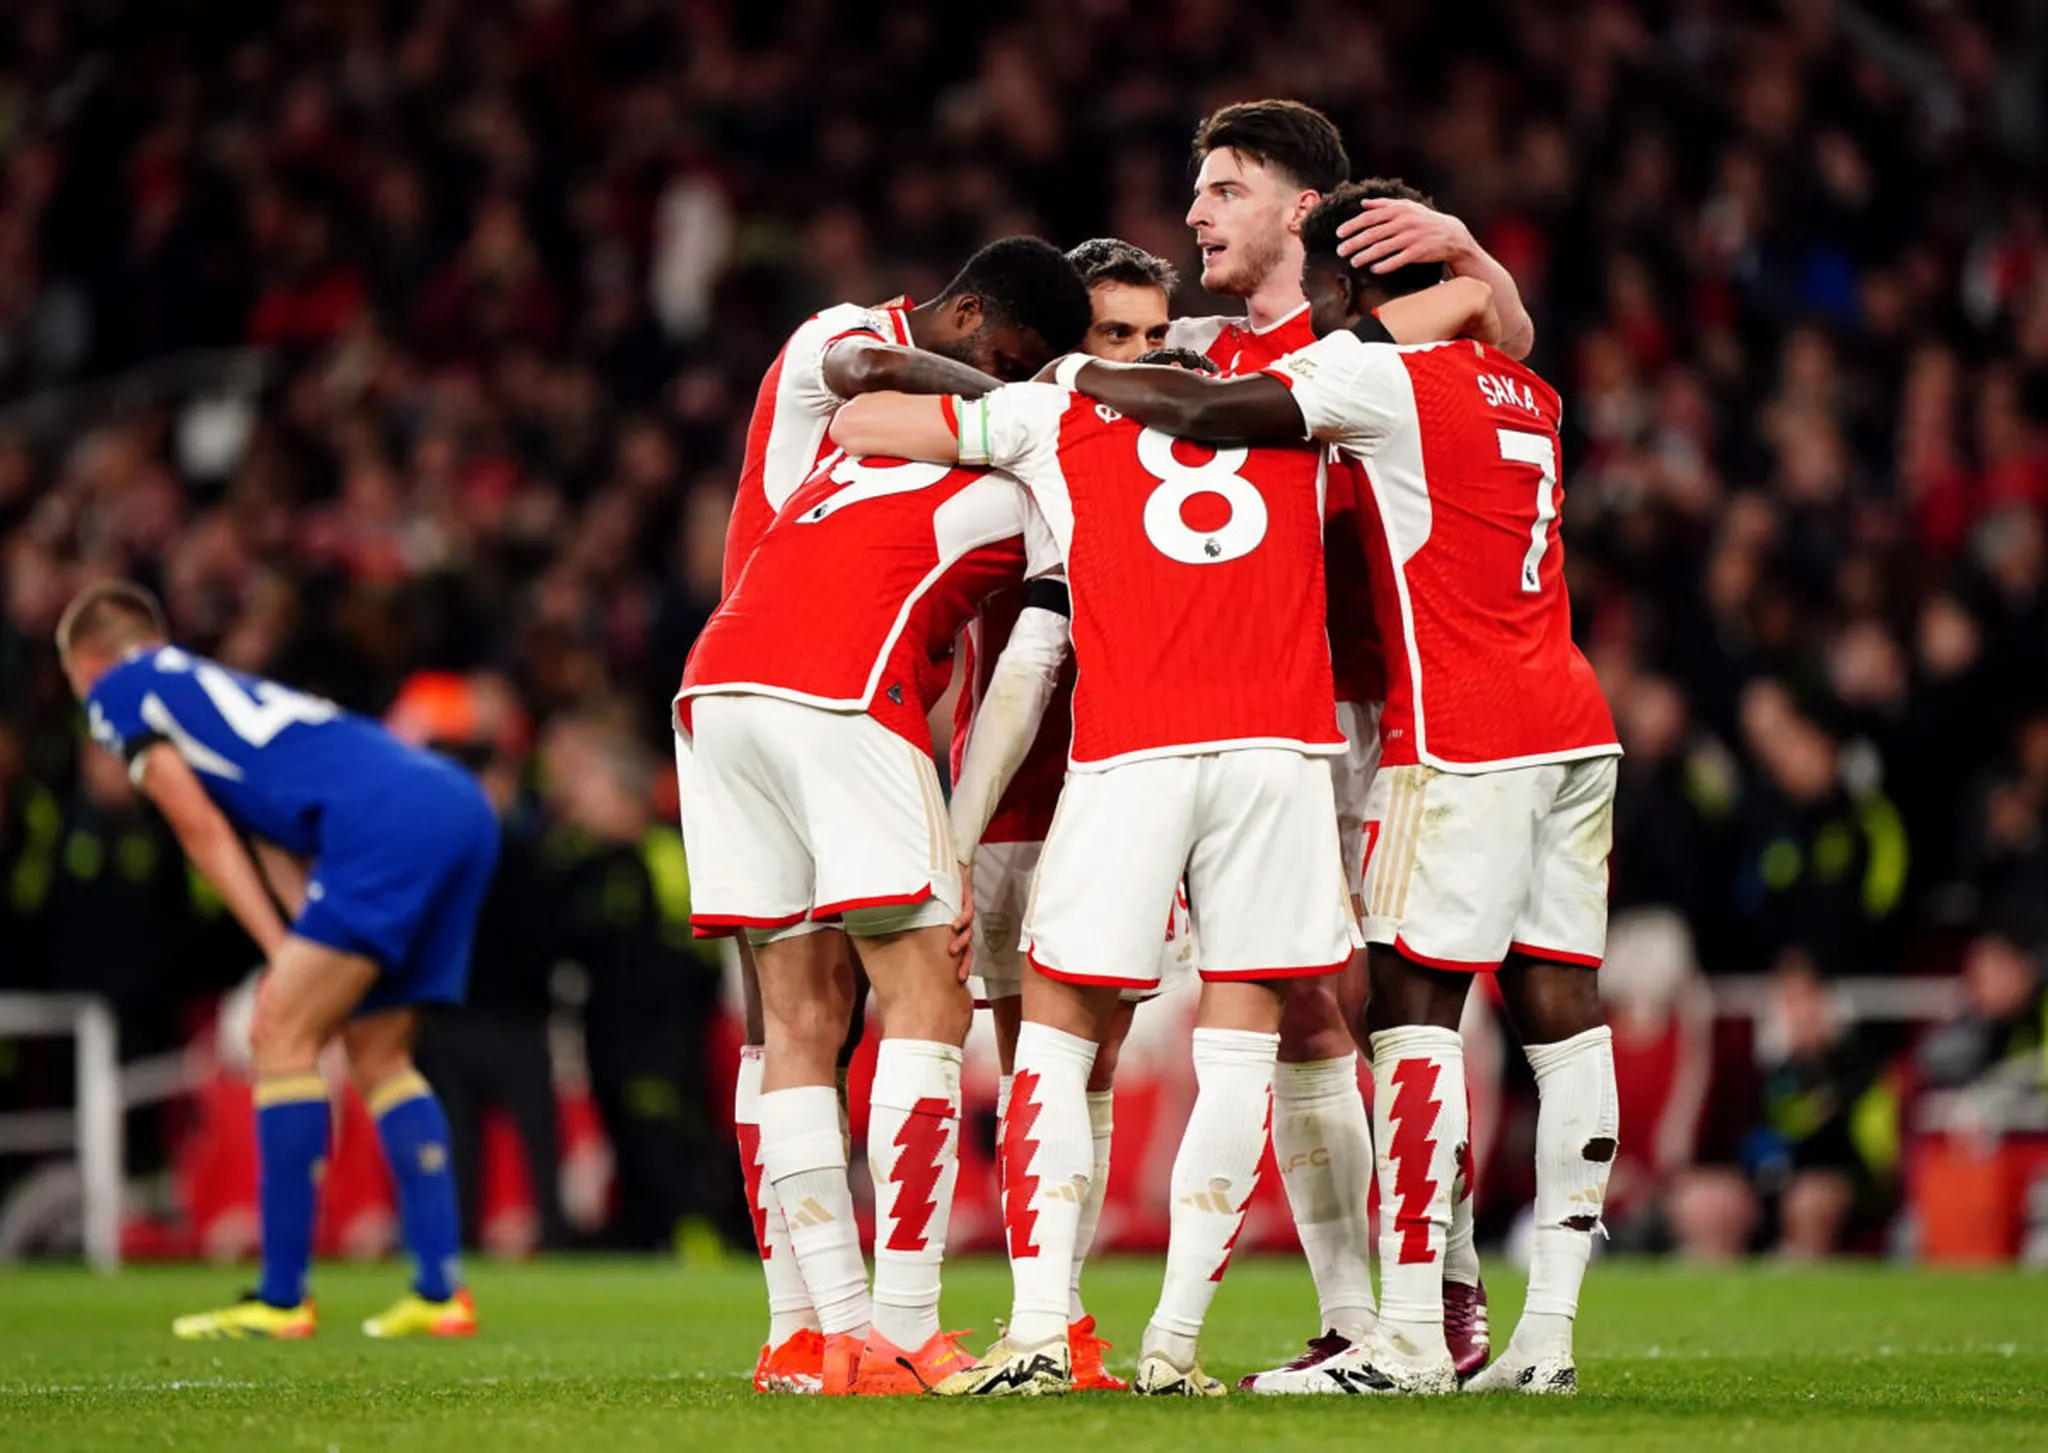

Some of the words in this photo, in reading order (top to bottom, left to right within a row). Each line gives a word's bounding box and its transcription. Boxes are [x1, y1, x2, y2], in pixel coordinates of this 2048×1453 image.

[1477, 373, 1541, 417] SAKA
[794, 447, 953, 524] 9
[1136, 426, 1269, 565] 8
[1496, 428, 1557, 593] 7
